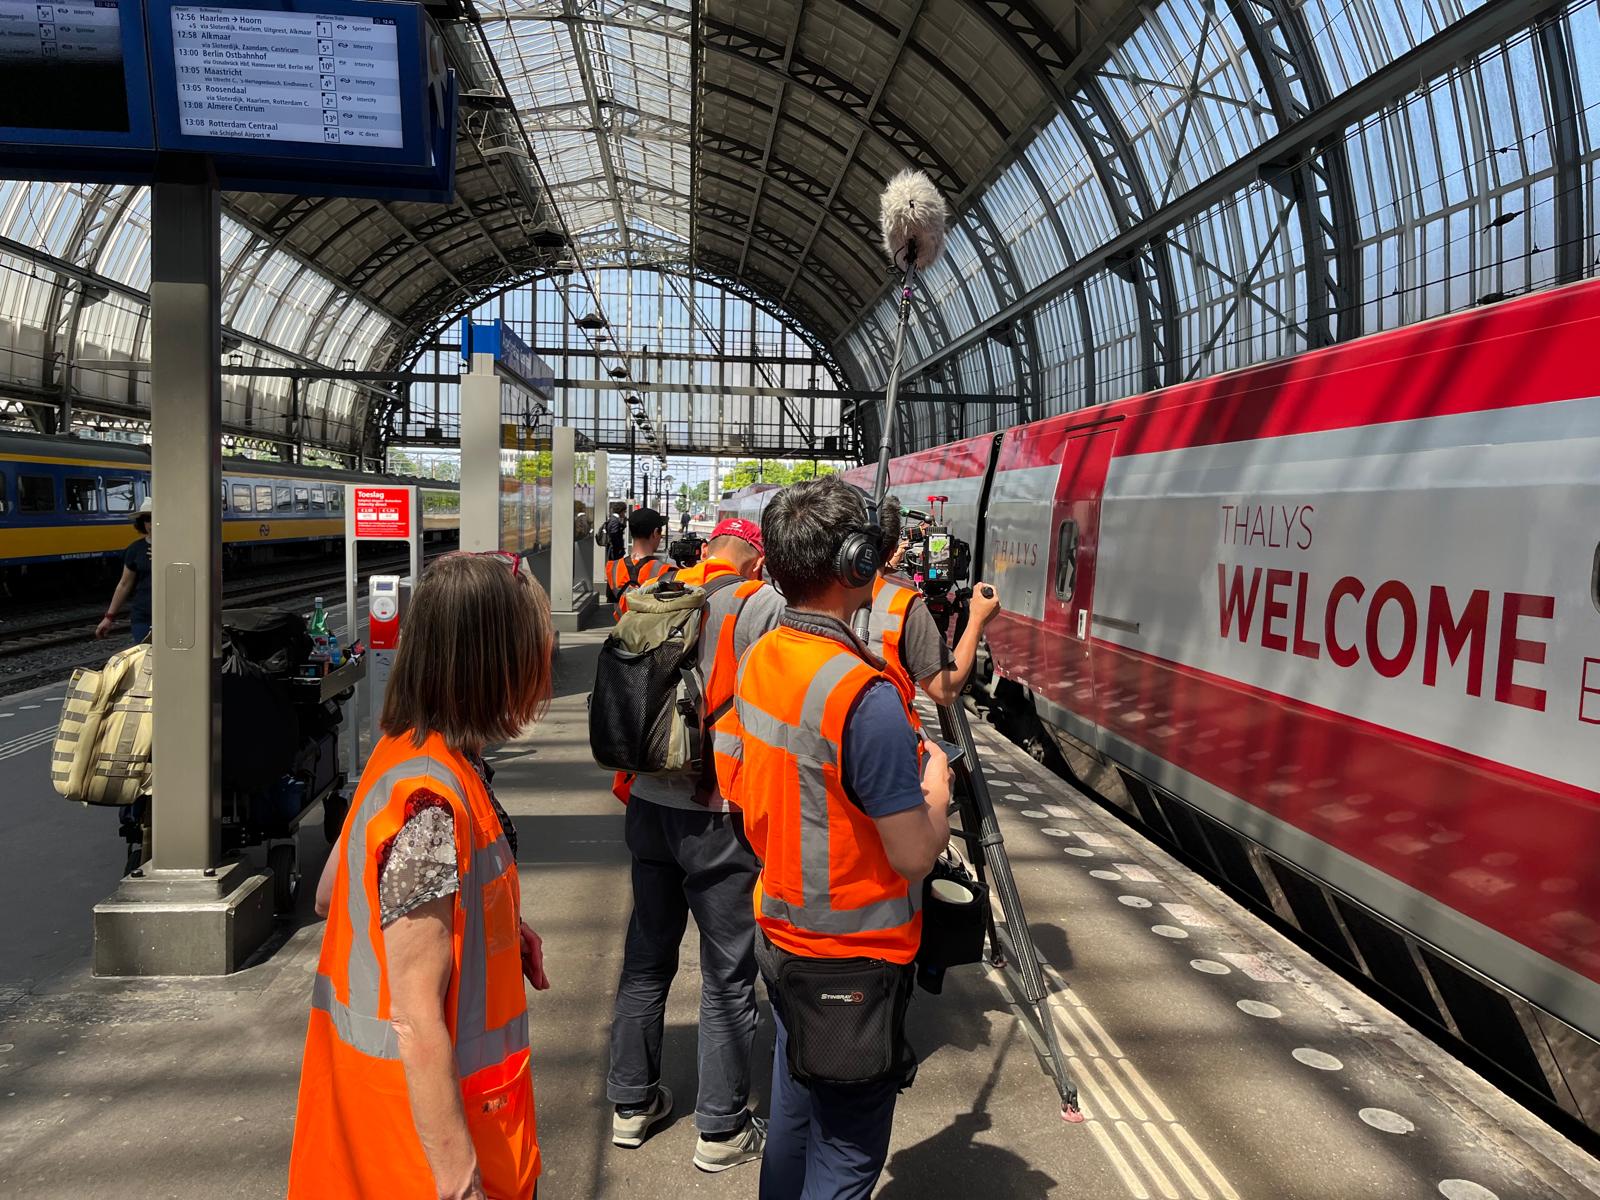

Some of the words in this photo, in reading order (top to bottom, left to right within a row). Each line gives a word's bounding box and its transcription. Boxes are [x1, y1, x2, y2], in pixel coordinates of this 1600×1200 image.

[200, 14, 230, 22] Haarlem
[202, 32, 231, 40] Alkmaar
[226, 51, 267, 60] Ostbahnhof
[204, 67, 242, 76] Maastricht
[206, 86, 247, 94] Roosendaal
[235, 104, 264, 112] Centrum
[209, 120, 246, 128] Rotterdam
[249, 122, 278, 130] Centraal
[642, 462, 650, 471] G
[98, 476, 104, 490] 2
[358, 491, 384, 500] Toeslag
[1222, 504, 1314, 550] THALYS
[992, 540, 1038, 566] THALYS
[1218, 562, 1556, 712] WELCOME
